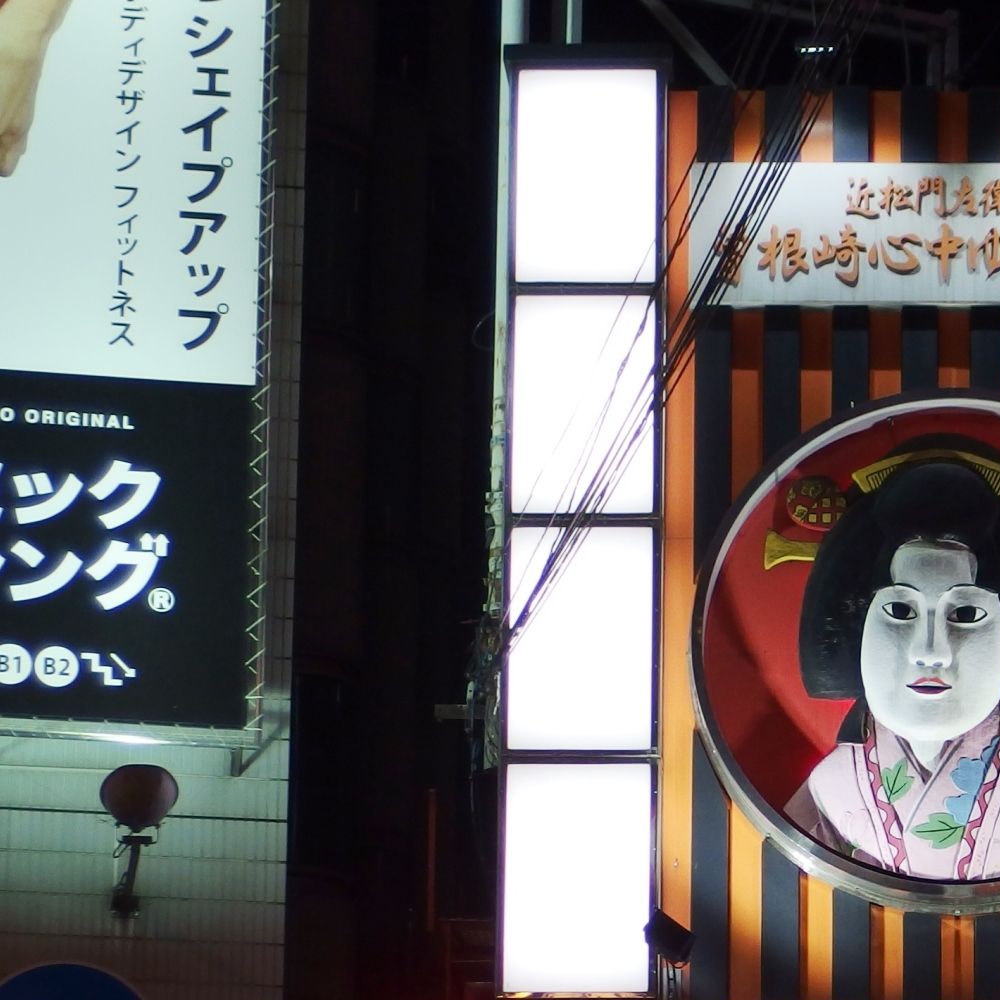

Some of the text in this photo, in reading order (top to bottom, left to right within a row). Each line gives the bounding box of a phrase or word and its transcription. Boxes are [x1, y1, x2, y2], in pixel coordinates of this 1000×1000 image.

[109, 0, 147, 346] ディデザインフィットネス
[179, 0, 233, 350] シェイプアップ
[0, 459, 161, 530] ック
[25, 409, 135, 430] ORIGINAL
